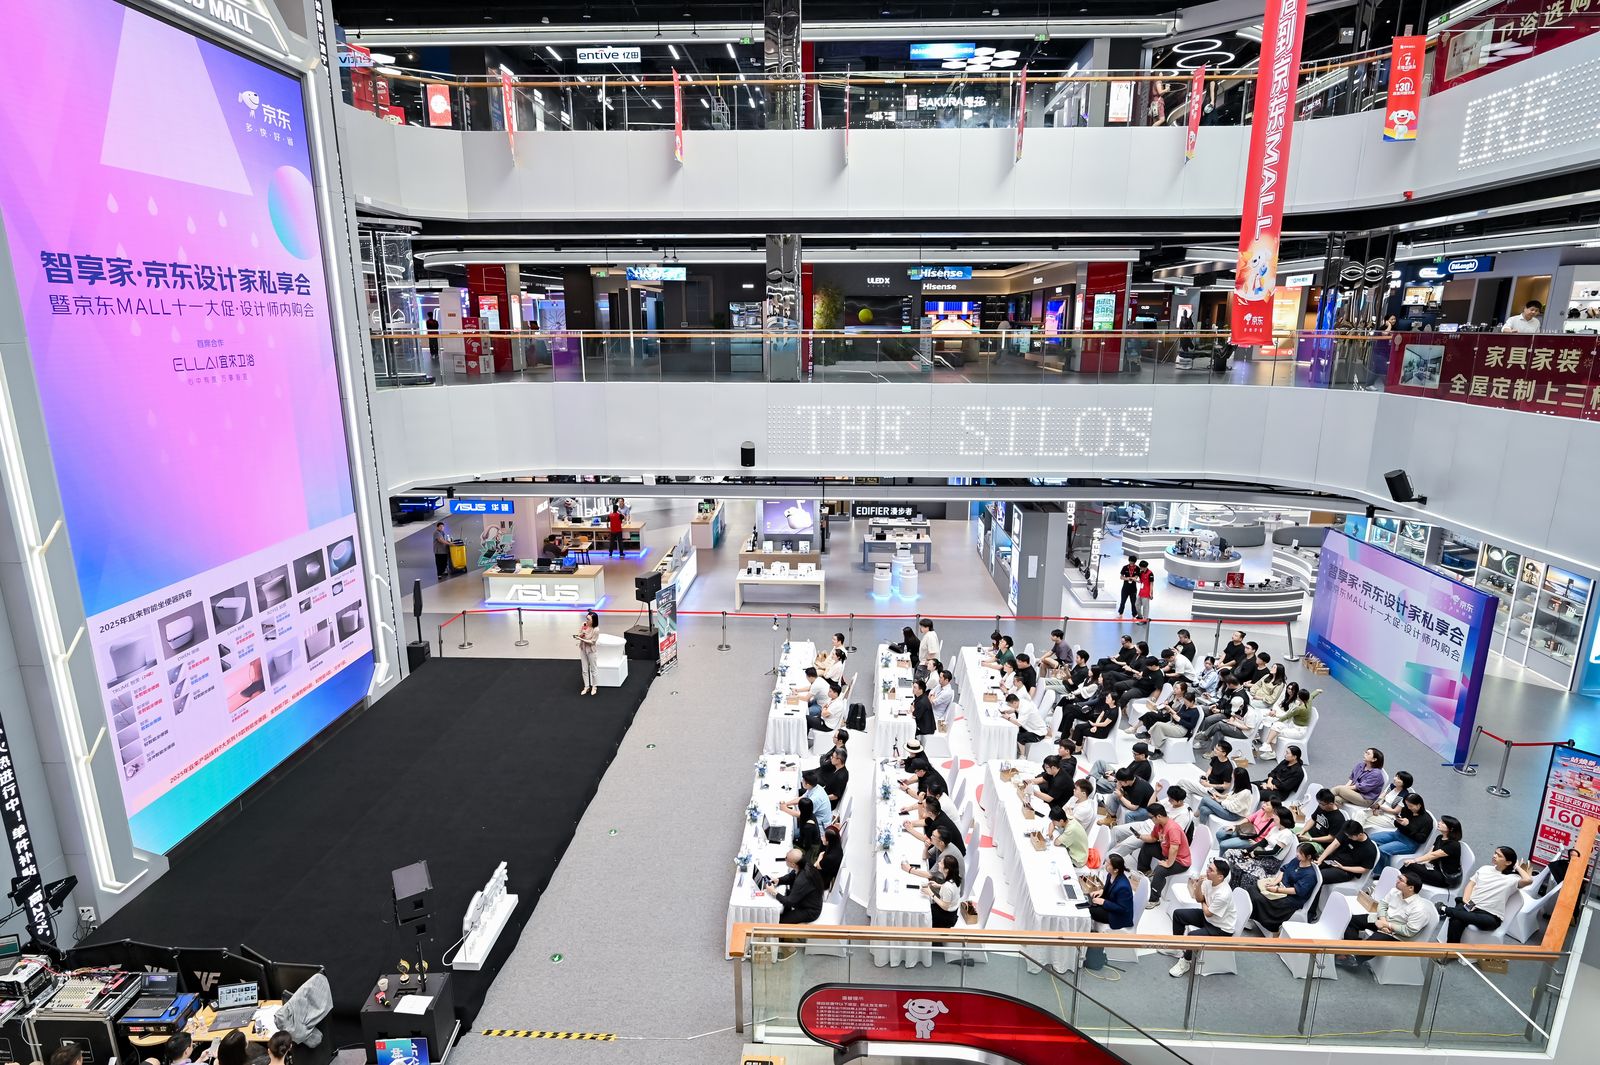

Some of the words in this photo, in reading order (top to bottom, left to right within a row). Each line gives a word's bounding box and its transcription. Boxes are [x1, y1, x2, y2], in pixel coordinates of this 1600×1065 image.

[208, 1, 254, 35] MALL
[1499, 0, 1600, 42] 卫浴选购
[578, 50, 619, 60] entive
[261, 103, 292, 131] 京东
[40, 250, 311, 296] 智享家·京东设计家私享会
[867, 277, 884, 285] ULED
[920, 269, 963, 278] Hisense
[49, 294, 314, 318] 暨京东MALL十一大促·设计师内购会
[1485, 345, 1582, 375] 家具家装
[796, 404, 911, 455] THE
[959, 406, 1153, 456] SILOS
[454, 503, 486, 511] ASUS
[491, 503, 509, 511] 华硕
[856, 506, 890, 516] EDIFIER
[890, 507, 913, 516] 漫步者
[501, 584, 580, 601] ASUS
[1327, 563, 1465, 647] 智享家·京东设计家私享会
[99, 589, 193, 634] 2025年宜来智能坐便器阵容
[1548, 805, 1584, 828] 160
